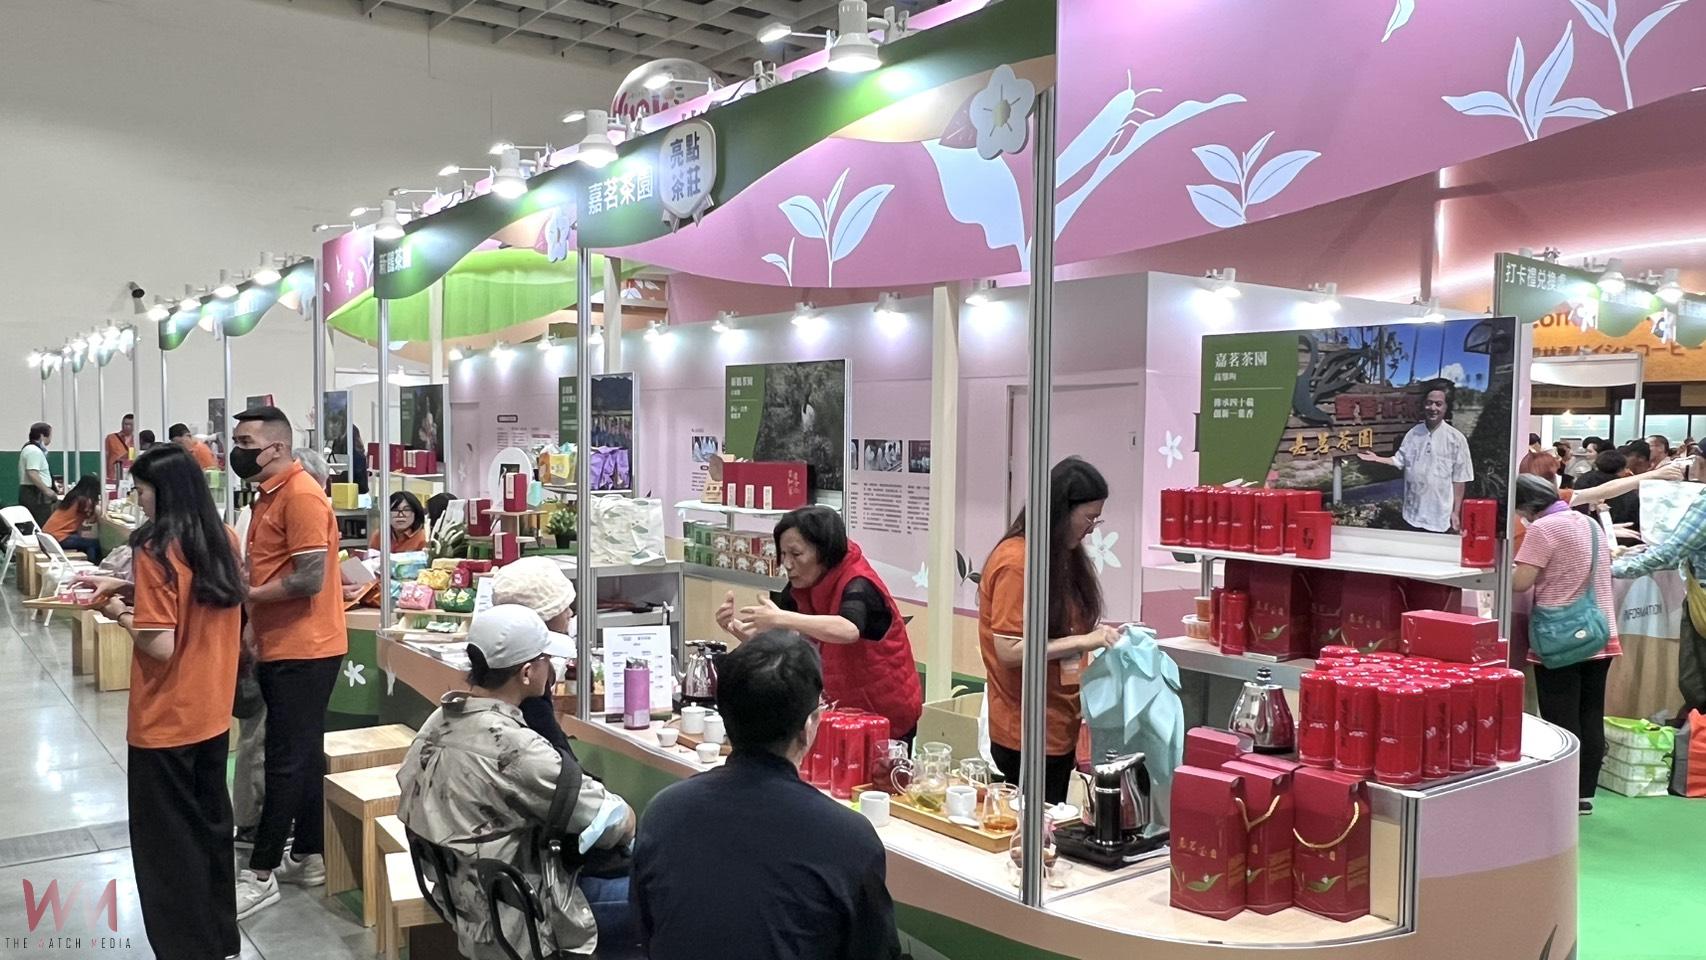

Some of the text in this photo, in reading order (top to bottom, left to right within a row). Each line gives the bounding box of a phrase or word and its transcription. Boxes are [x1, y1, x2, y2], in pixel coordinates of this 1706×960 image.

[670, 131, 700, 168] 亮點
[587, 168, 654, 215] 嘉茗茶園
[671, 164, 701, 201] 茶莊
[1215, 351, 1268, 368] 嘉茗茶園
[1288, 428, 1373, 457] 嘉茗茶園
[1624, 604, 1662, 621] INFORMATION
